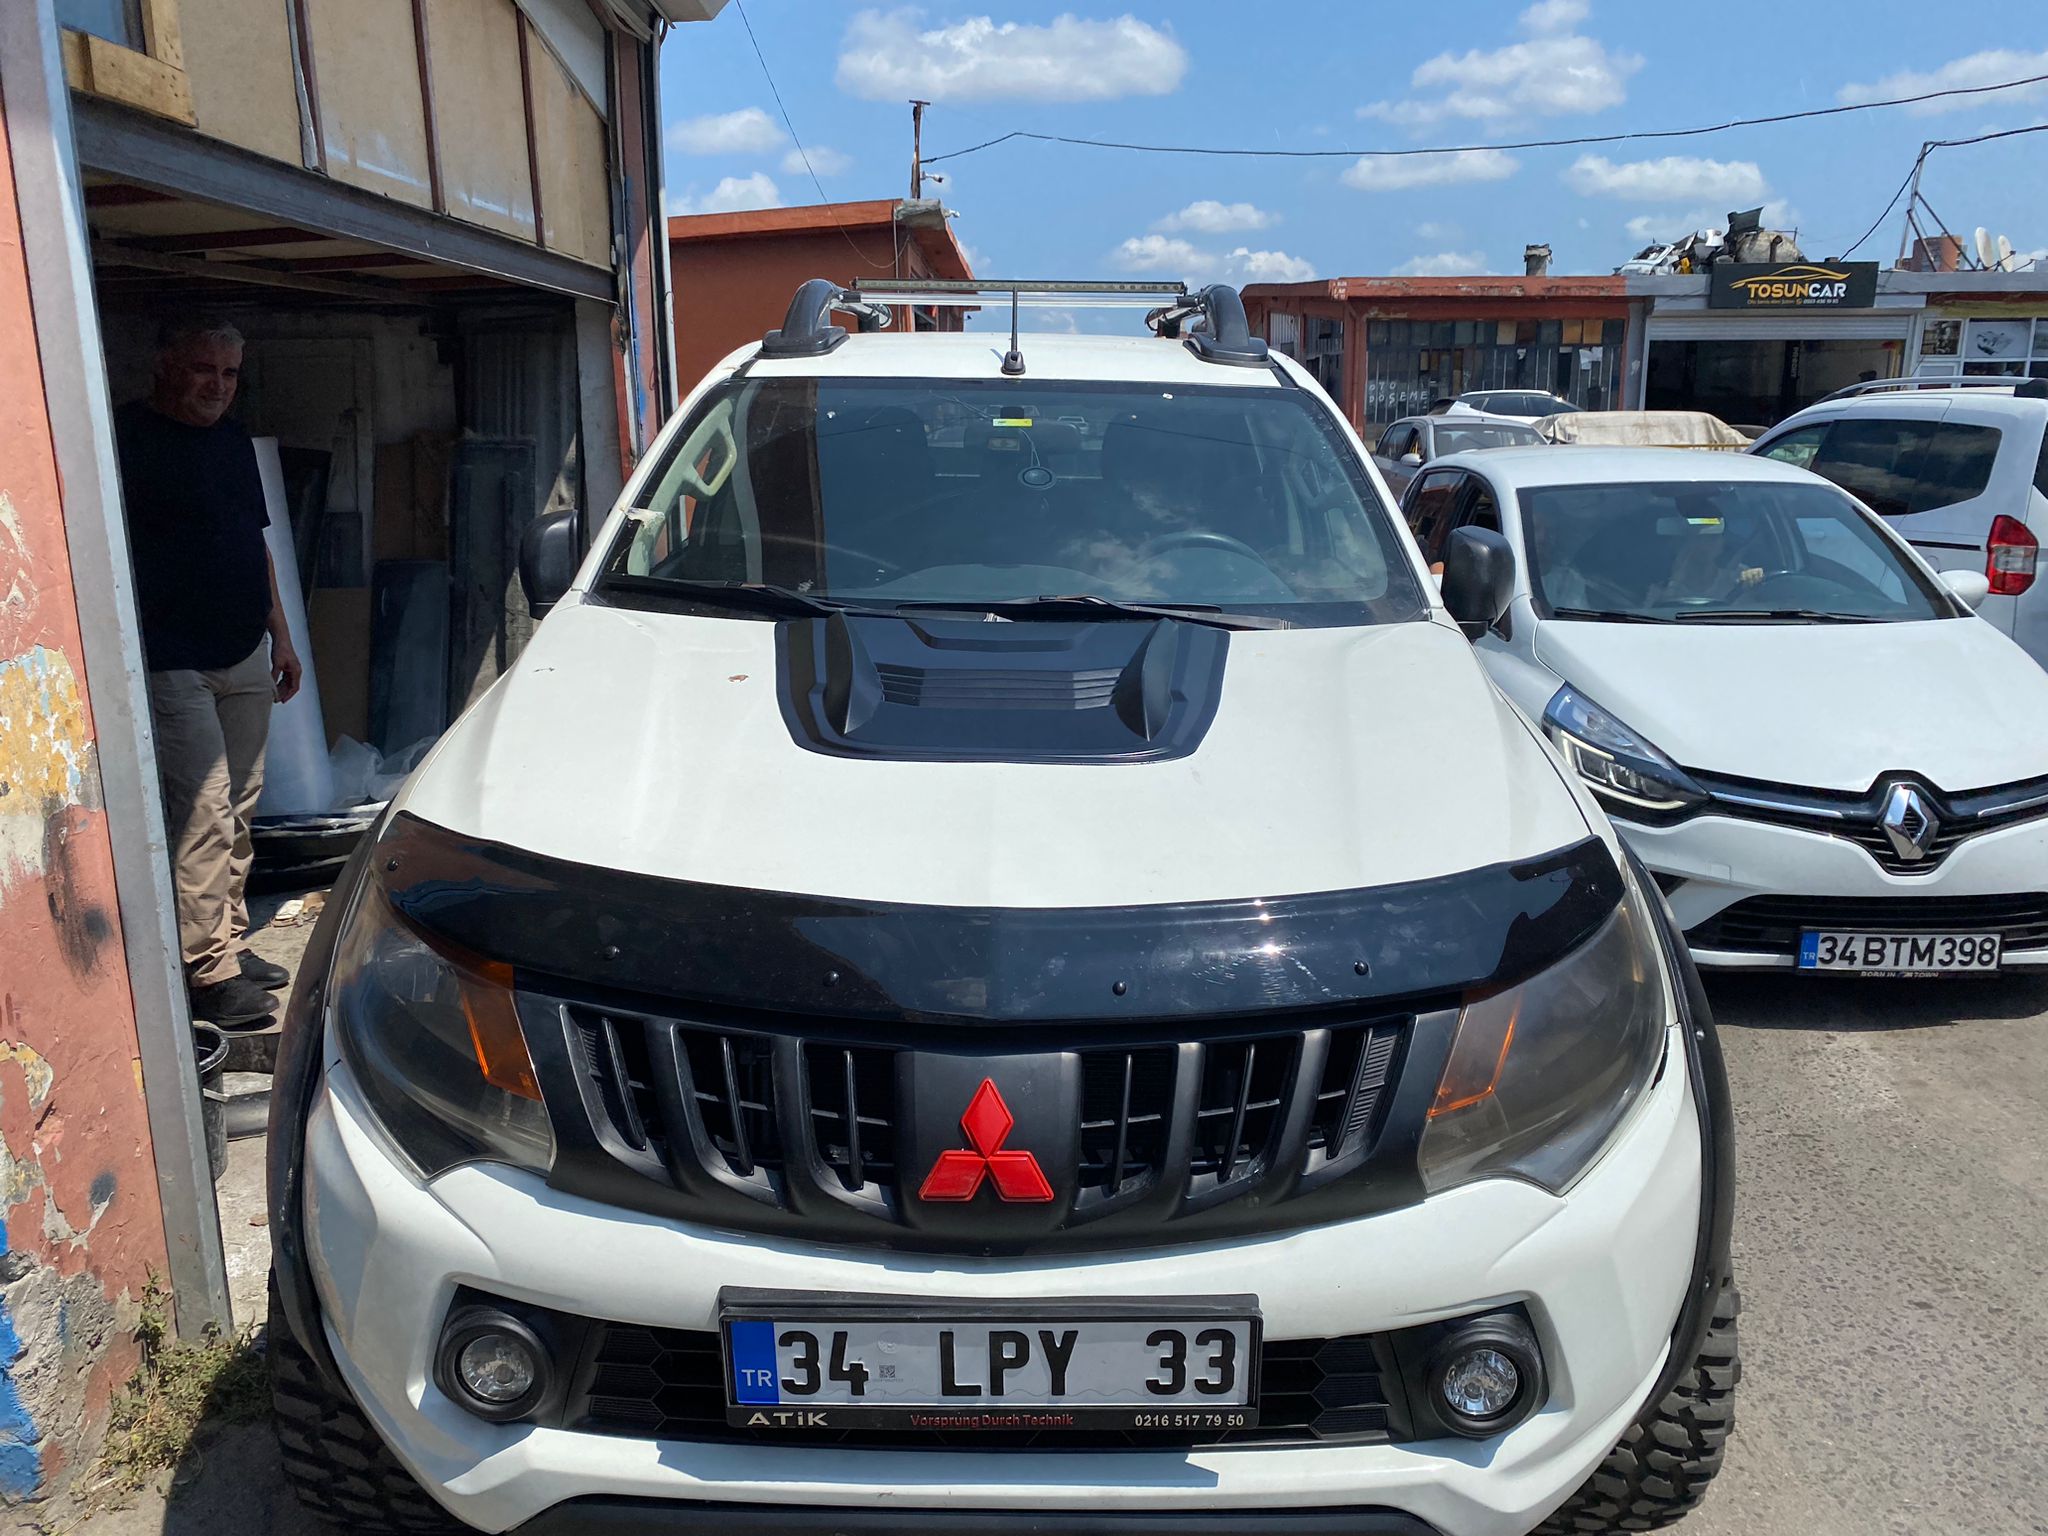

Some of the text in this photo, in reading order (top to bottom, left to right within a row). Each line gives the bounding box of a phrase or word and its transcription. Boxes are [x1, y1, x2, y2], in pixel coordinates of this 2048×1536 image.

[1748, 282, 1847, 298] TOSUNCAR
[1368, 381, 1397, 391] OTO
[1803, 951, 1816, 961] TR
[778, 1328, 1237, 1396] 34 LPY 33
[741, 1369, 773, 1387] TR
[910, 1414, 979, 1428] Vorsprung
[982, 1414, 1020, 1426] Durch
[1023, 1414, 1074, 1426] Technik
[1135, 1414, 1170, 1427] 0216
[1174, 1414, 1200, 1427] 517
[1205, 1414, 1222, 1427] 79
[1227, 1414, 1244, 1427] 50
